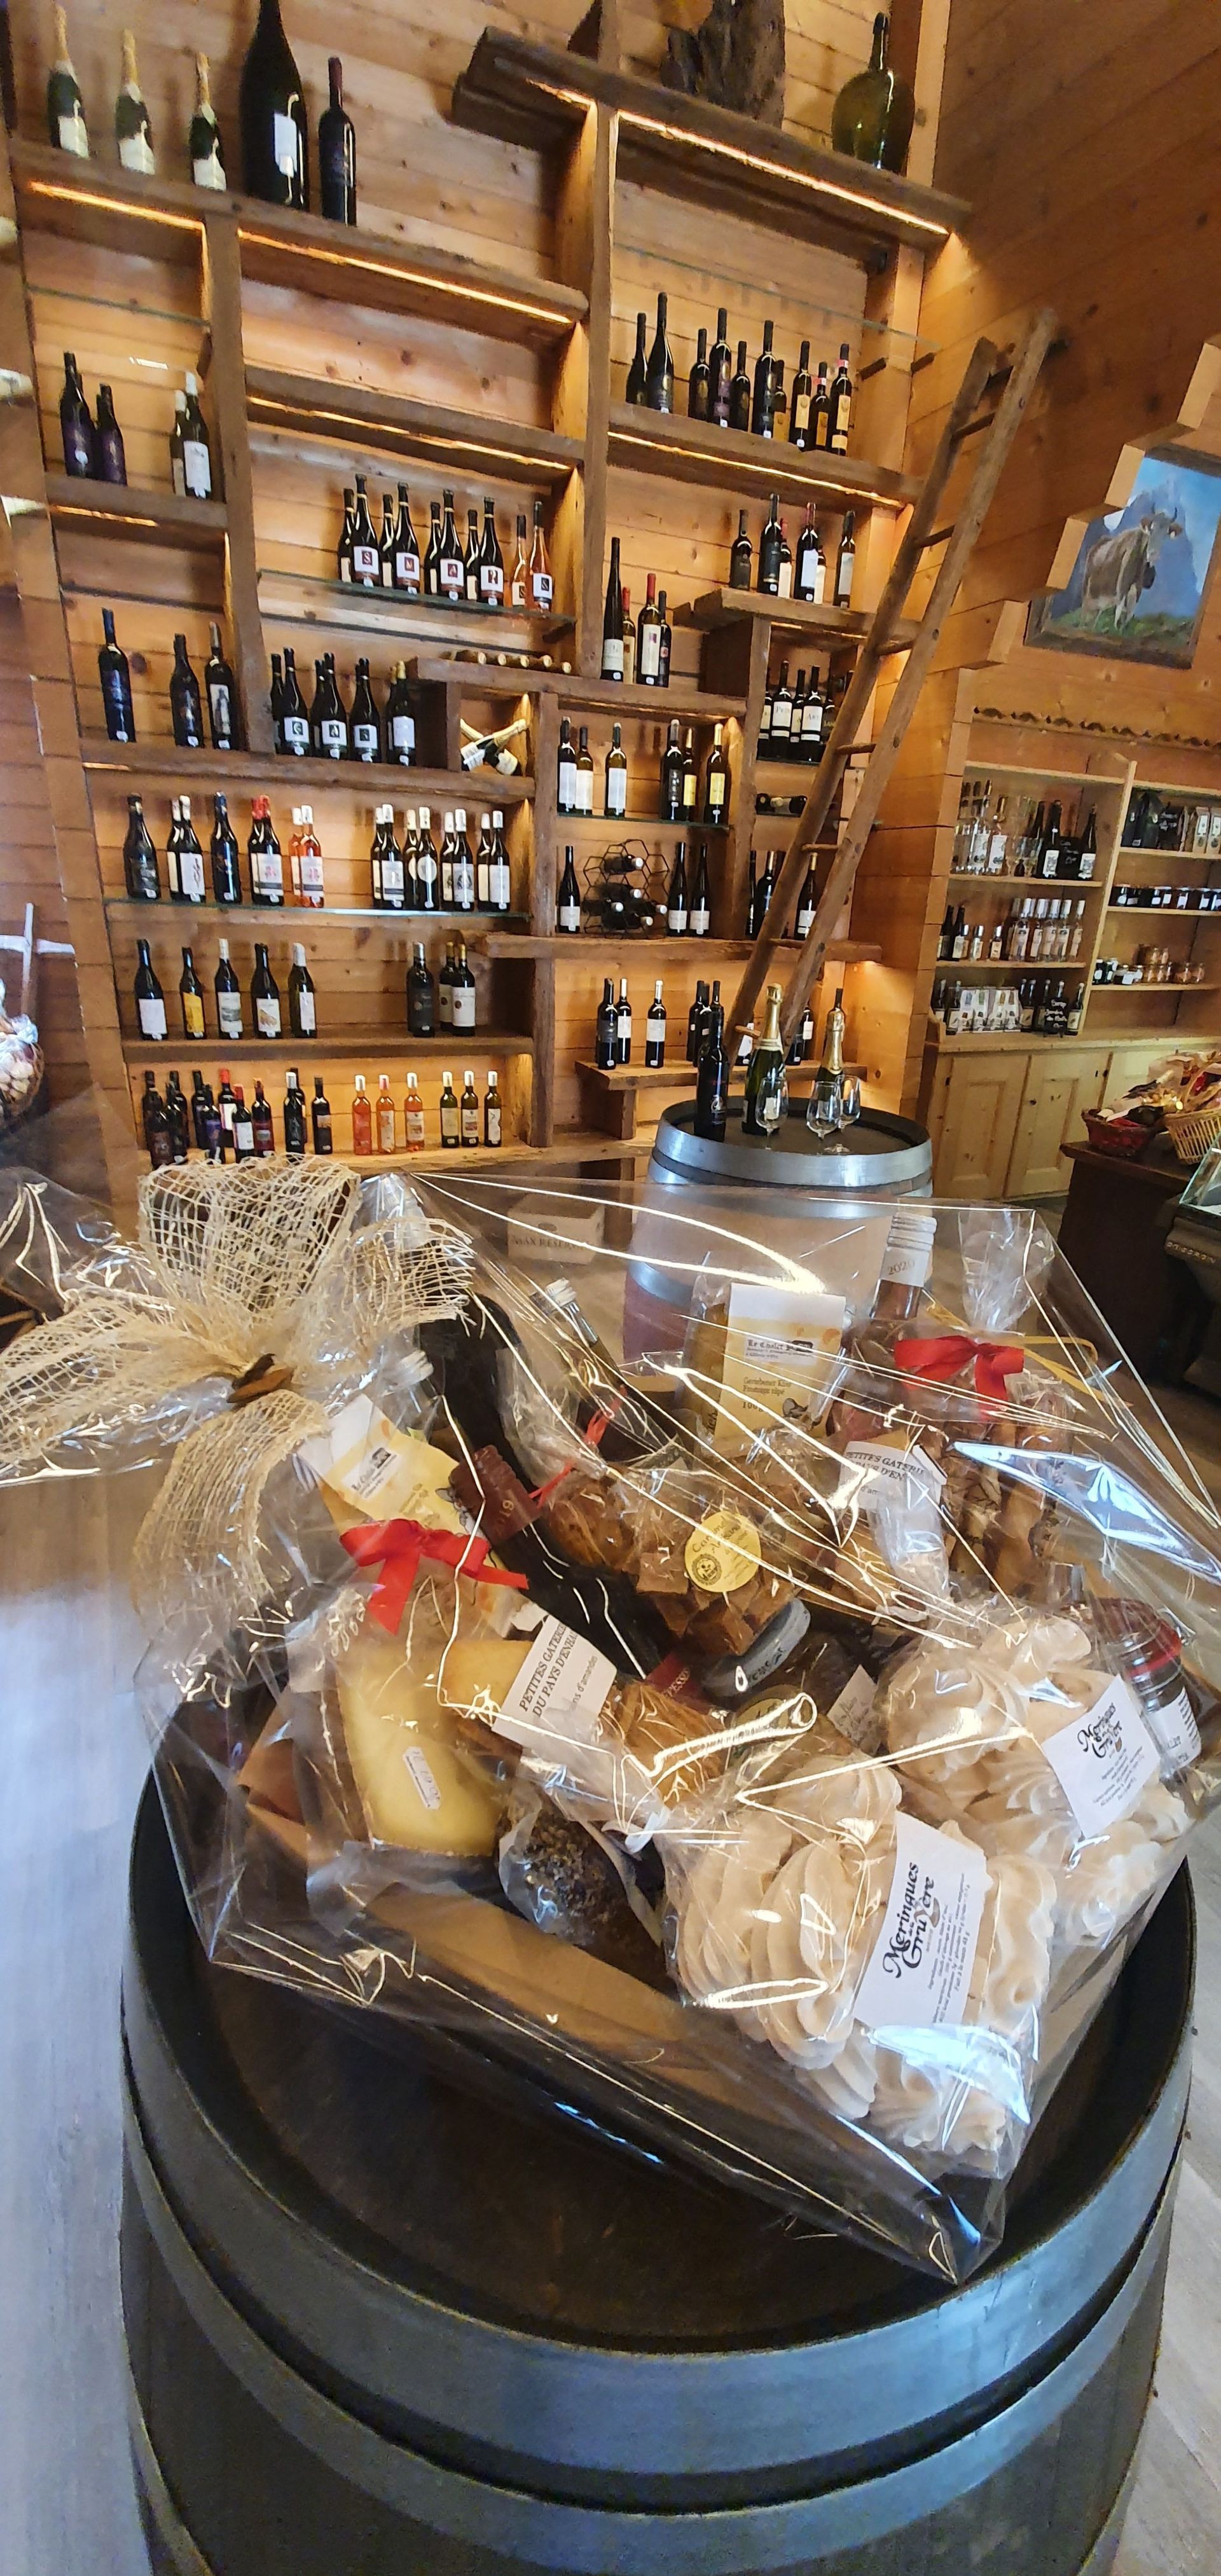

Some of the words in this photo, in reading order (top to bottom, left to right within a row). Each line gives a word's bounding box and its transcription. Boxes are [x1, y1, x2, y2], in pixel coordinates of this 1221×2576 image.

[520, 1661, 548, 1712] PETITES
[532, 1696, 546, 1717] DU
[542, 1665, 561, 1698] PAYS
[883, 1862, 919, 1978] Meringues
